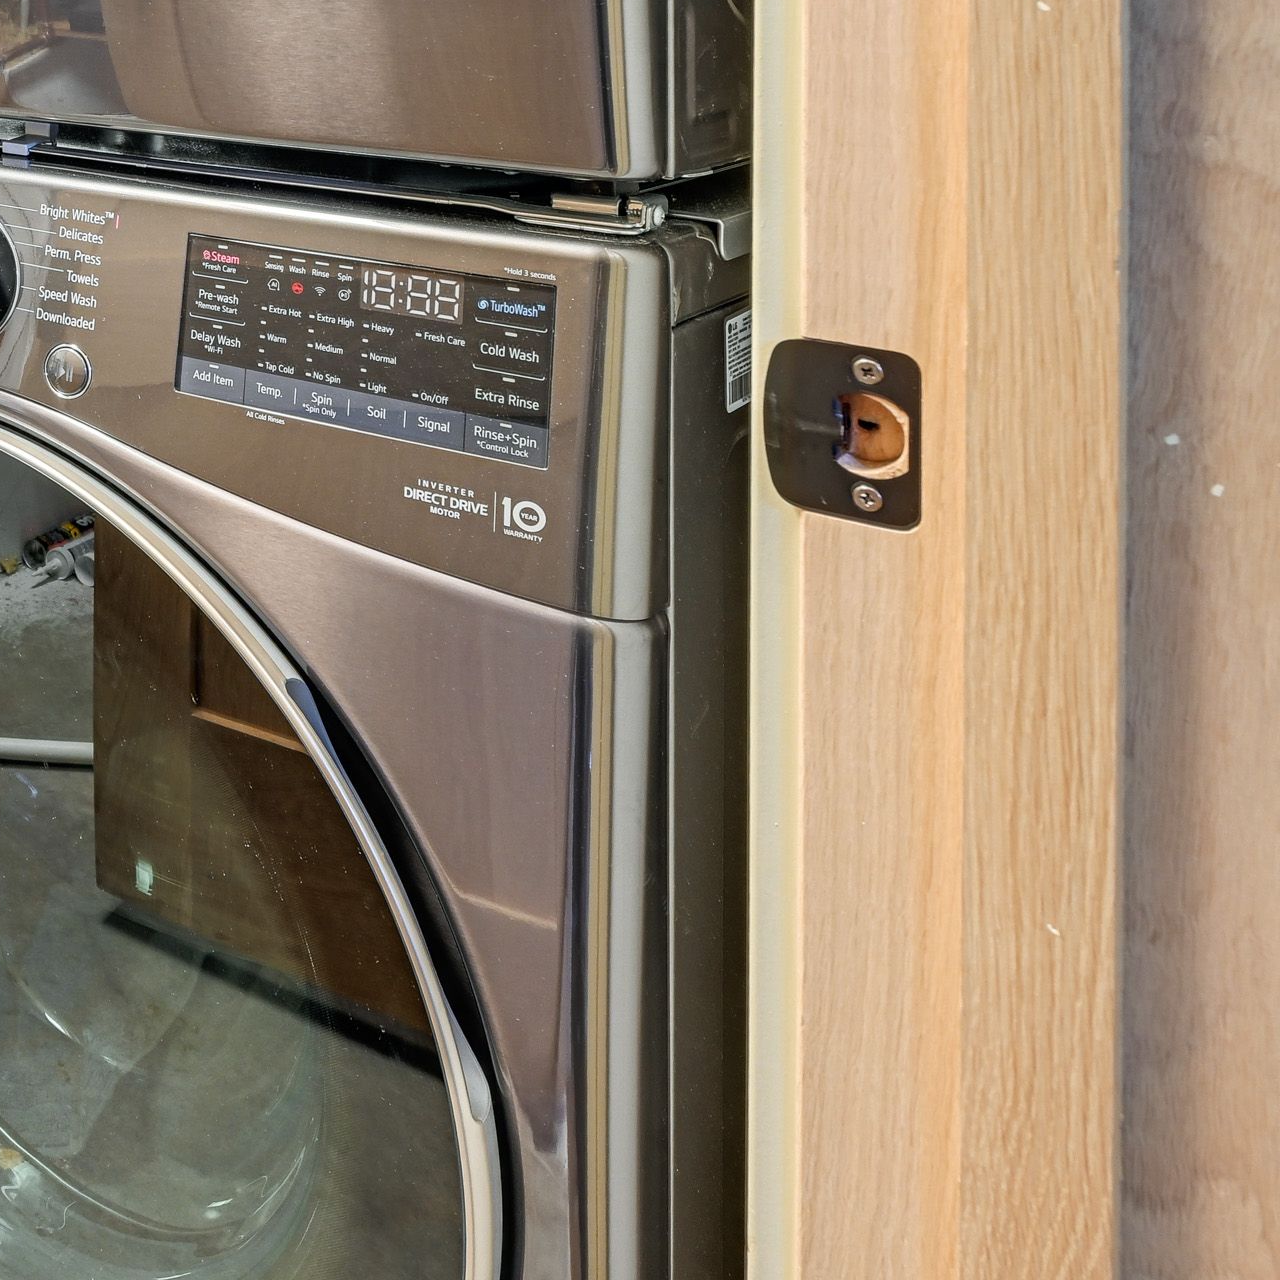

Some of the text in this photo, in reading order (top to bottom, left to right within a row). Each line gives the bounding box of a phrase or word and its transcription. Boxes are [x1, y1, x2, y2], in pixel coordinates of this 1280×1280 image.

[40, 204, 69, 220] Bright
[59, 226, 104, 245] Delicates
[45, 245, 101, 266] Perm. Press
[211, 251, 240, 265] Steam
[223, 265, 237, 274] Care
[265, 262, 284, 272] Sensing
[289, 266, 306, 275] Wash
[312, 269, 330, 278] Rinse
[67, 270, 99, 287] Towels
[337, 273, 353, 282] Spin
[530, 271, 557, 281] seconds
[39, 286, 97, 308] Speed Wash
[198, 289, 239, 305] Pre-wash
[222, 305, 238, 315] Start
[269, 305, 302, 318] Extra Hot
[36, 308, 95, 331] Downloaded
[317, 313, 355, 328] Extra High
[371, 323, 395, 336] Heavy
[190, 330, 241, 349] Delay Wash
[267, 333, 287, 344] Warm
[424, 331, 466, 347] Fresh Care
[315, 342, 344, 355] Medium
[480, 343, 540, 363] Cold Wash
[369, 352, 397, 365] Normal
[265, 361, 295, 375] Tap Cold
[193, 370, 234, 387] Add Item
[313, 372, 341, 385] No Spin
[256, 382, 283, 399] Temp.
[367, 382, 387, 394] Light
[311, 392, 333, 407] Spin
[420, 392, 449, 405] On/Off
[475, 388, 540, 411] Extra Rinse
[254, 412, 267, 421] Cold
[267, 415, 286, 425] Rinses
[321, 407, 337, 419] Only
[367, 406, 386, 420] Soil
[417, 417, 450, 433] Signal
[474, 426, 537, 449] Rinse+Spin
[510, 447, 529, 458] Lock
[417, 478, 475, 498] INVERTER
[403, 486, 489, 517] DIRECT DRIVE
[429, 505, 461, 520] MOTOR
[502, 496, 547, 533] 10
[520, 512, 539, 521] YEAR
[503, 528, 543, 543] WARRANTY
